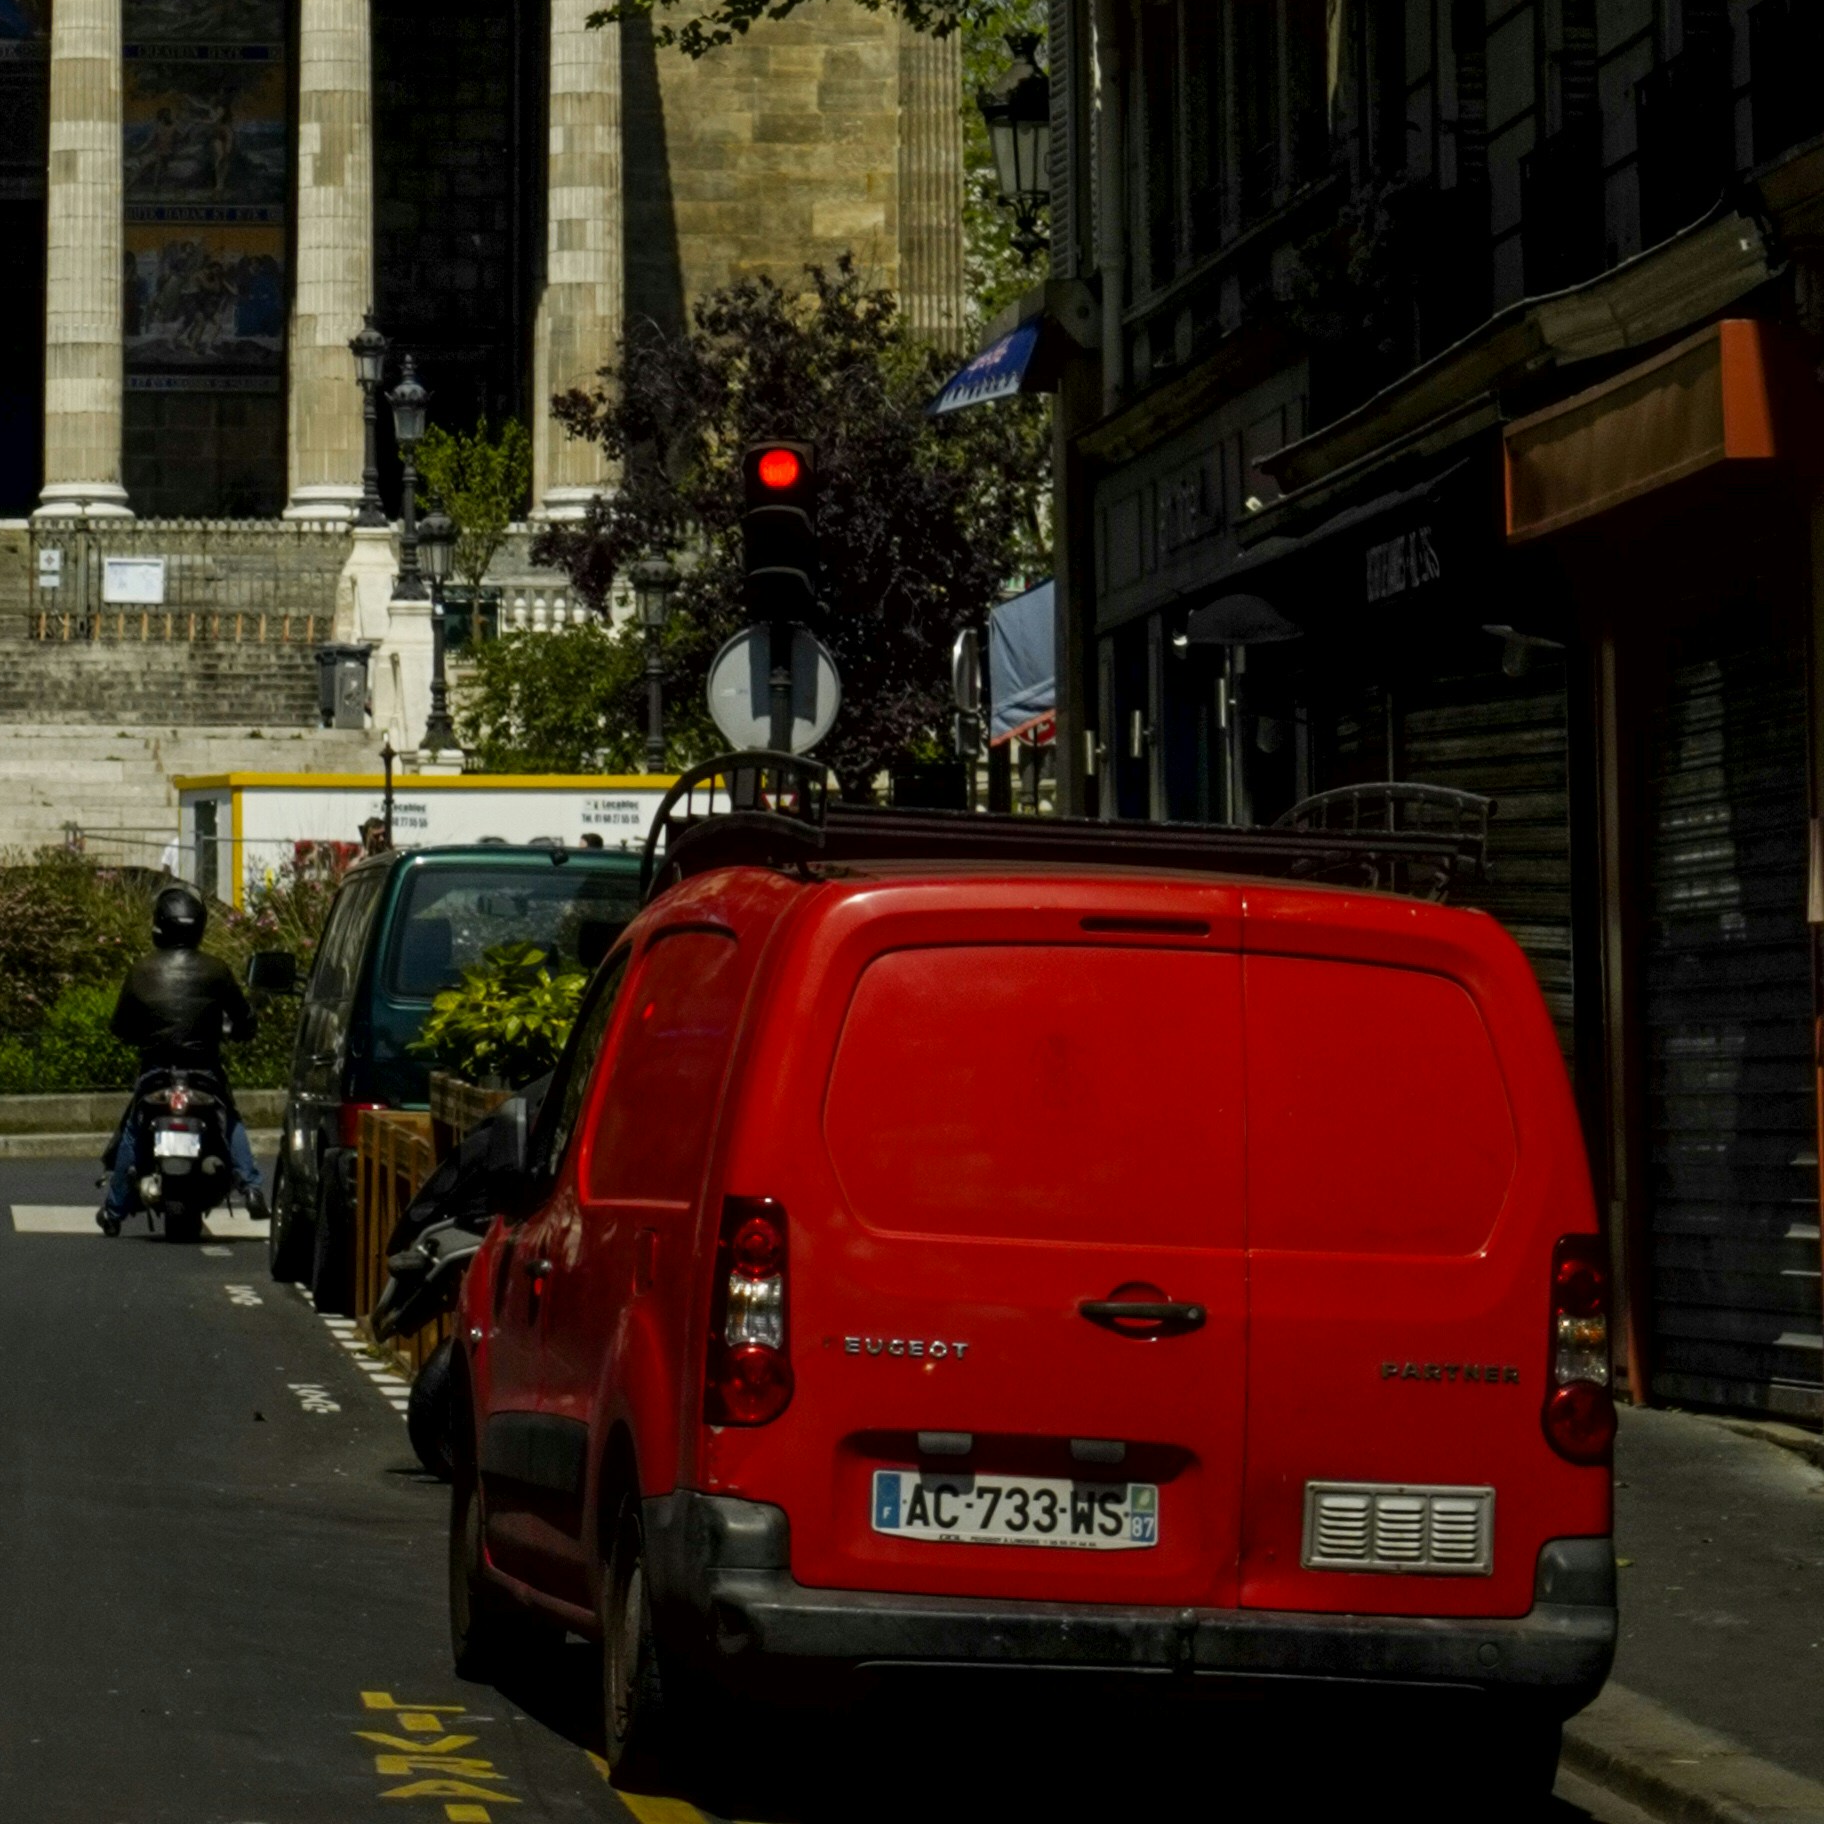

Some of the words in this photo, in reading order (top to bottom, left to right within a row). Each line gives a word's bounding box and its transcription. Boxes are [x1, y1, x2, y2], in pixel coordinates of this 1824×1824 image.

[1380, 1361, 1521, 1384] PARTNER
[882, 1506, 892, 1520] F
[905, 1483, 1125, 1537] AC-733-WS
[1131, 1515, 1156, 1539] 87
